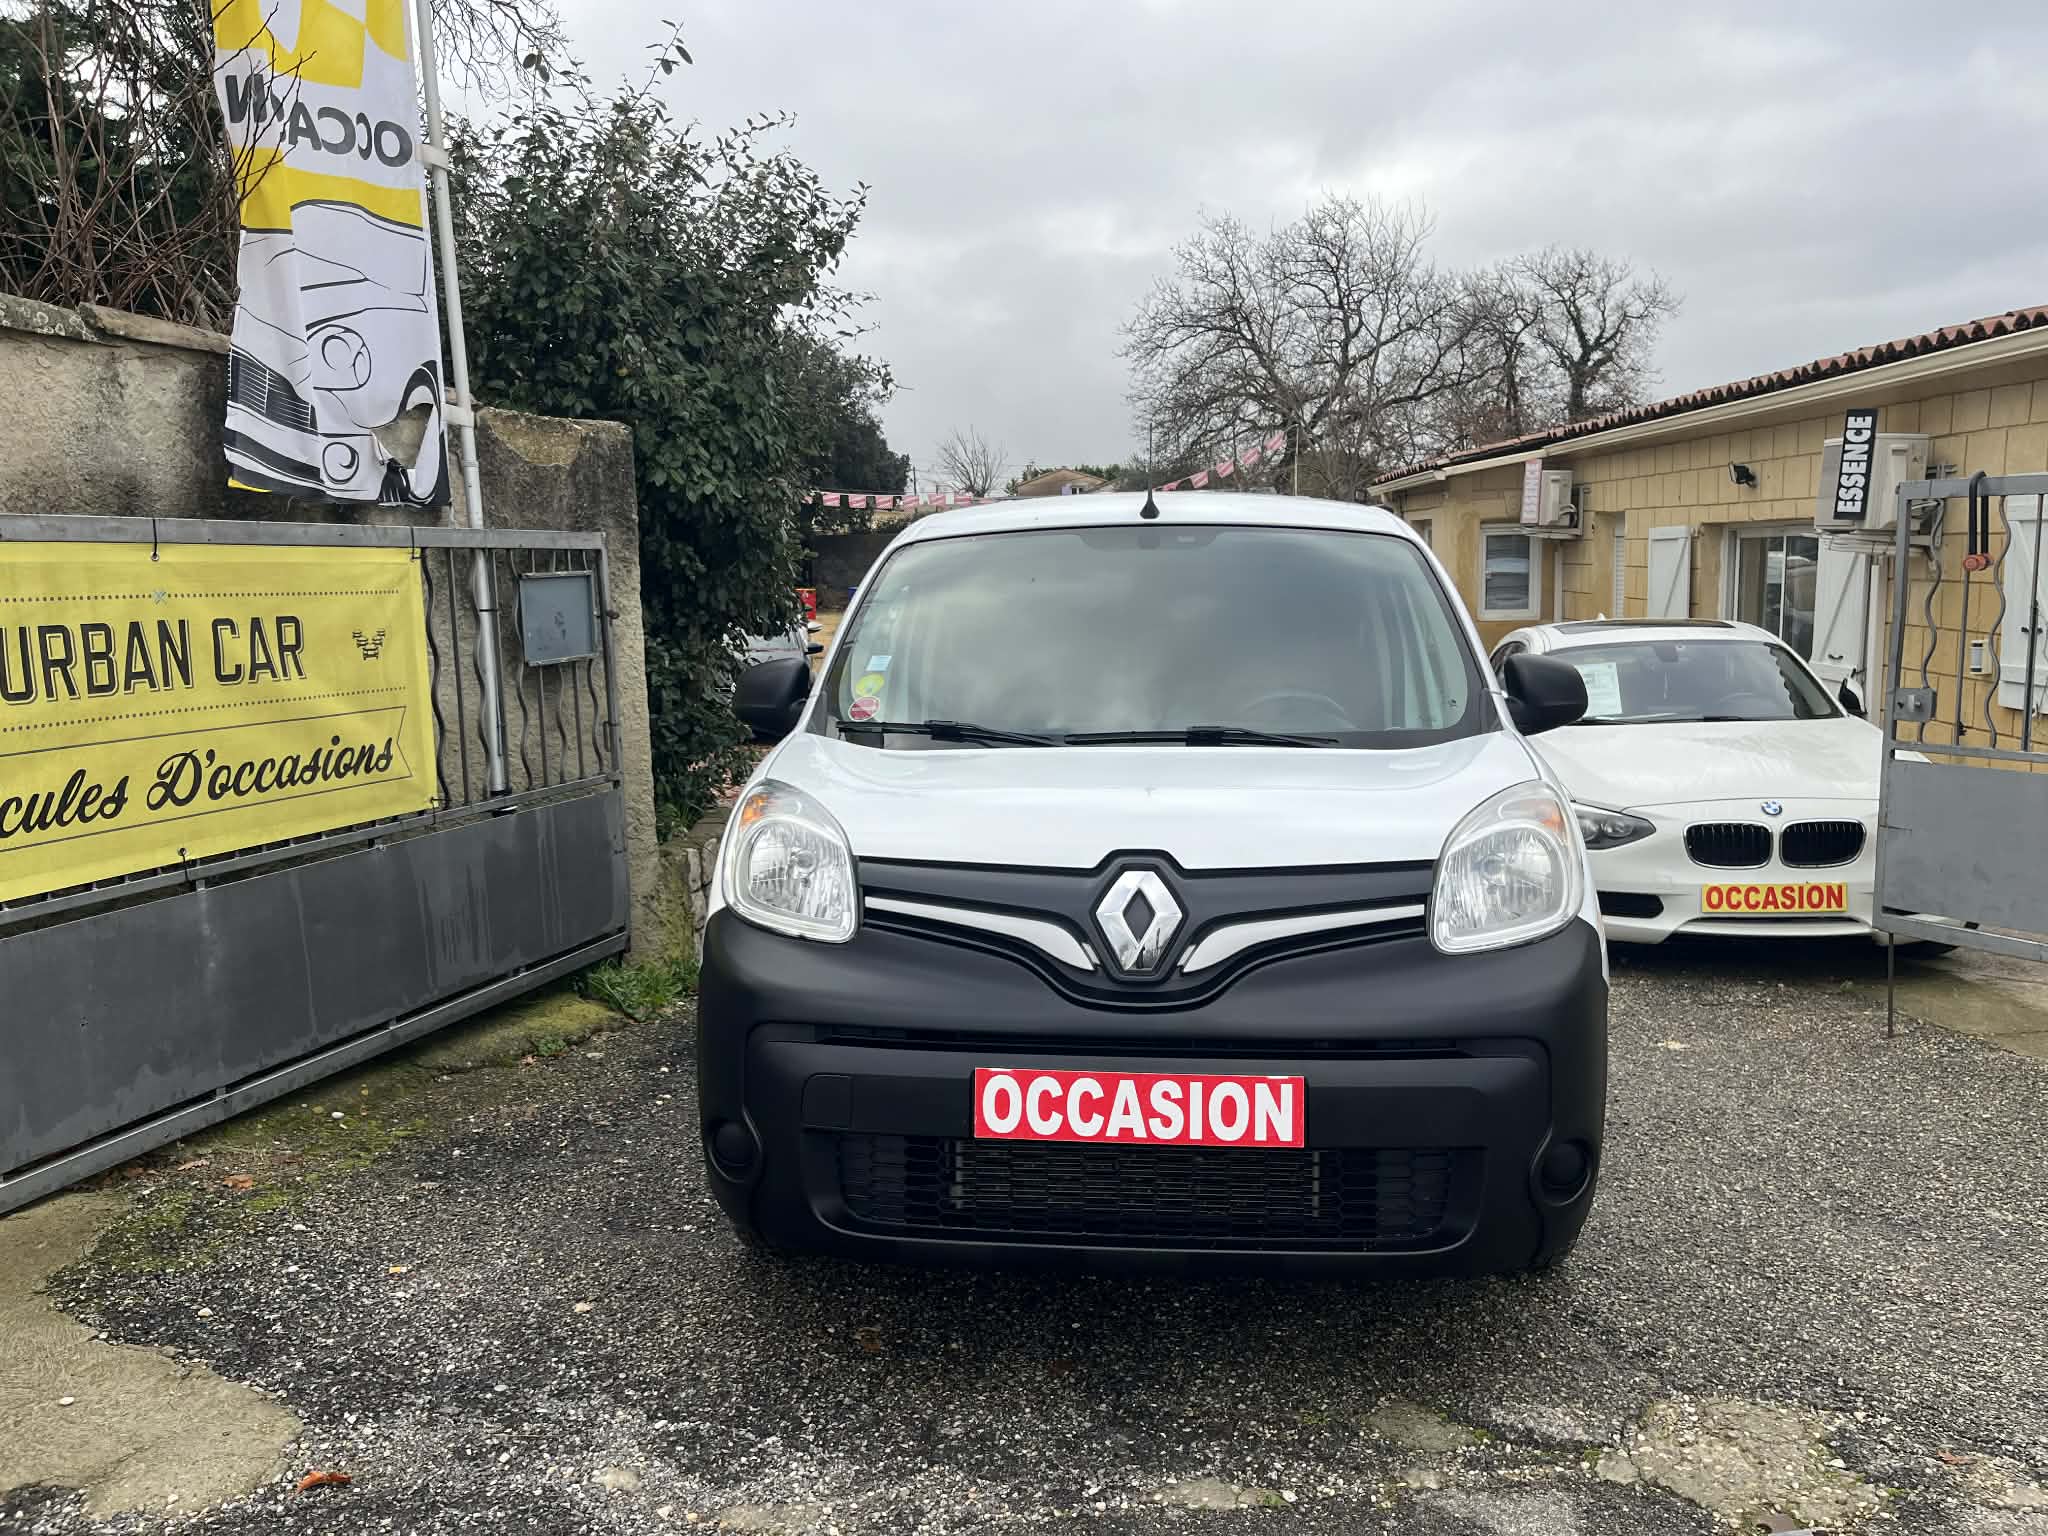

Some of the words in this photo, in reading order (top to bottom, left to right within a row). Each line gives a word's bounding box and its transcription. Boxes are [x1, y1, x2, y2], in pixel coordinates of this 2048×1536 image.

[1837, 416, 1873, 512] ESSENCE
[0, 619, 194, 705] URBAN
[211, 615, 306, 686] CAR
[146, 735, 393, 811] D'occasions
[1705, 885, 1843, 910] OCCASION
[982, 1074, 1293, 1142] OCCASION
